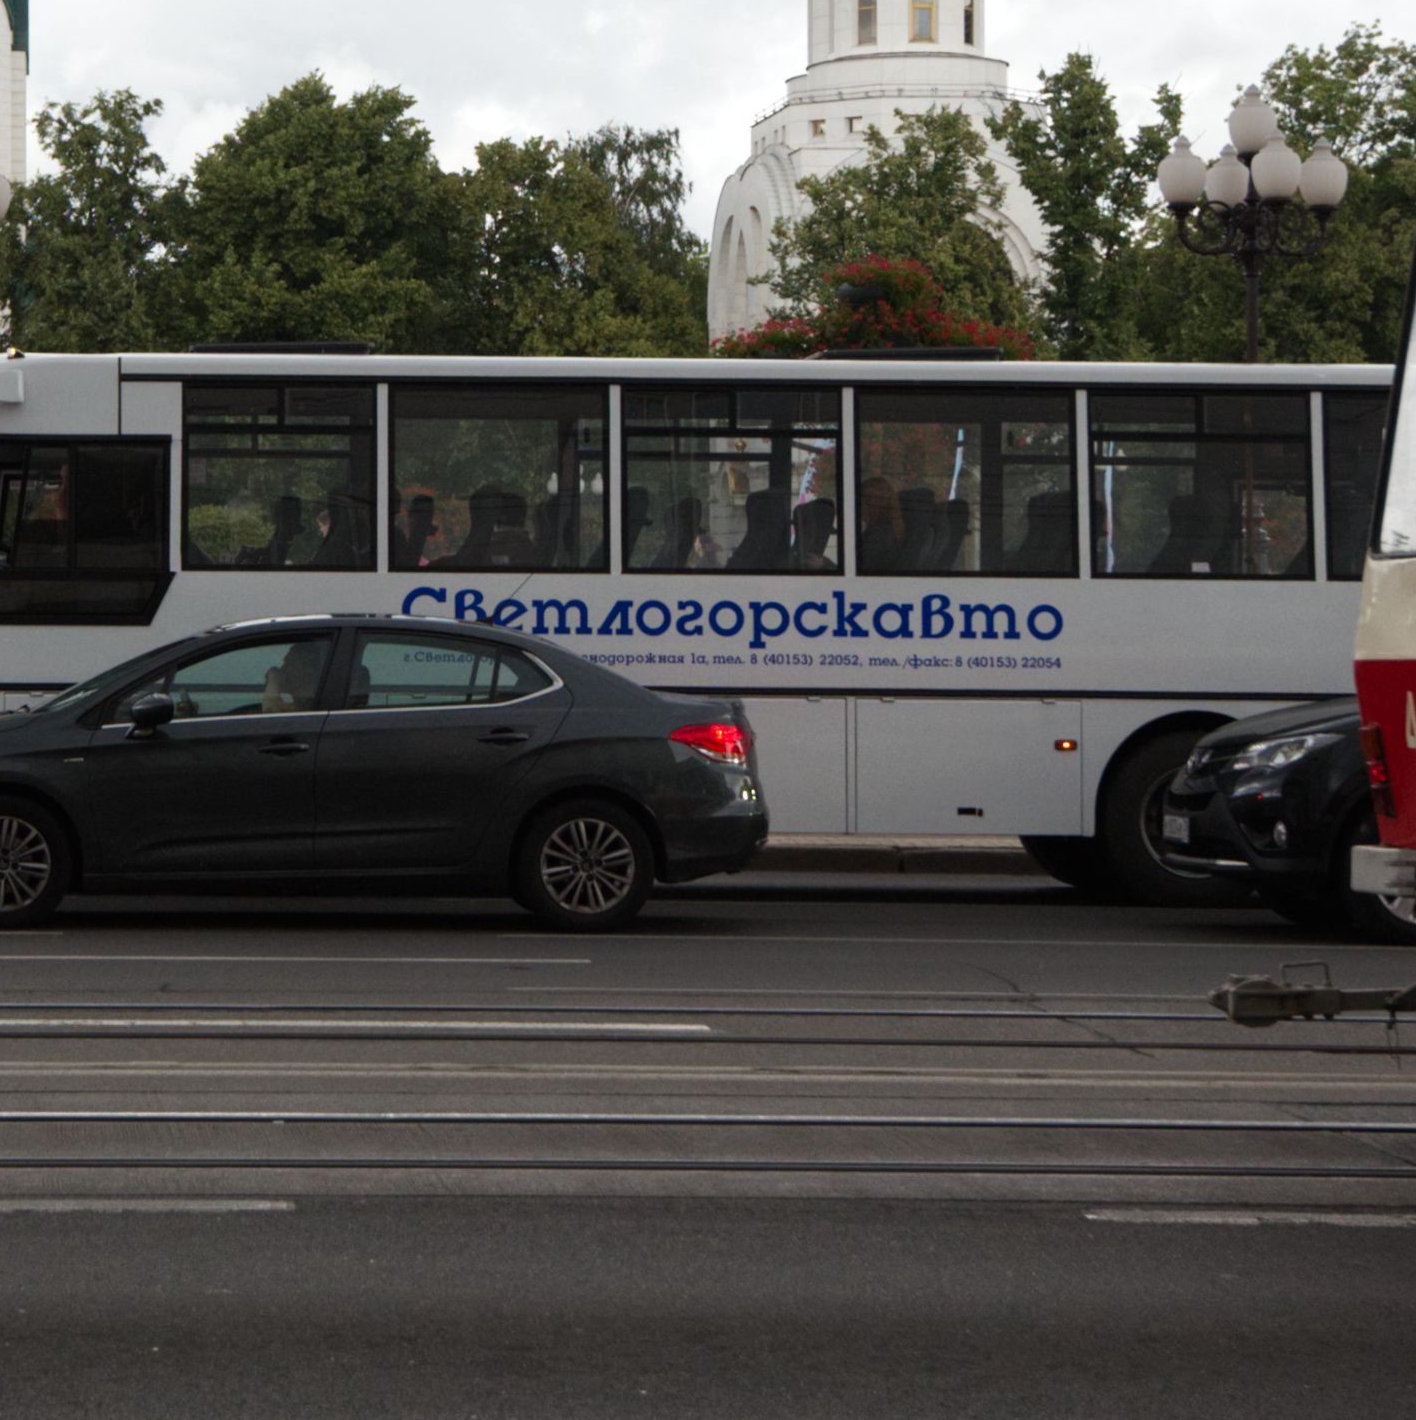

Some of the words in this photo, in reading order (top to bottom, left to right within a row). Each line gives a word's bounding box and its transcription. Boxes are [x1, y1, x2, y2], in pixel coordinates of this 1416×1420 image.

[750, 653, 758, 665] 8
[763, 653, 814, 667] (40153)
[819, 653, 863, 668] 22052,
[967, 656, 1018, 669] (40153)
[1020, 656, 1062, 669] 22054
